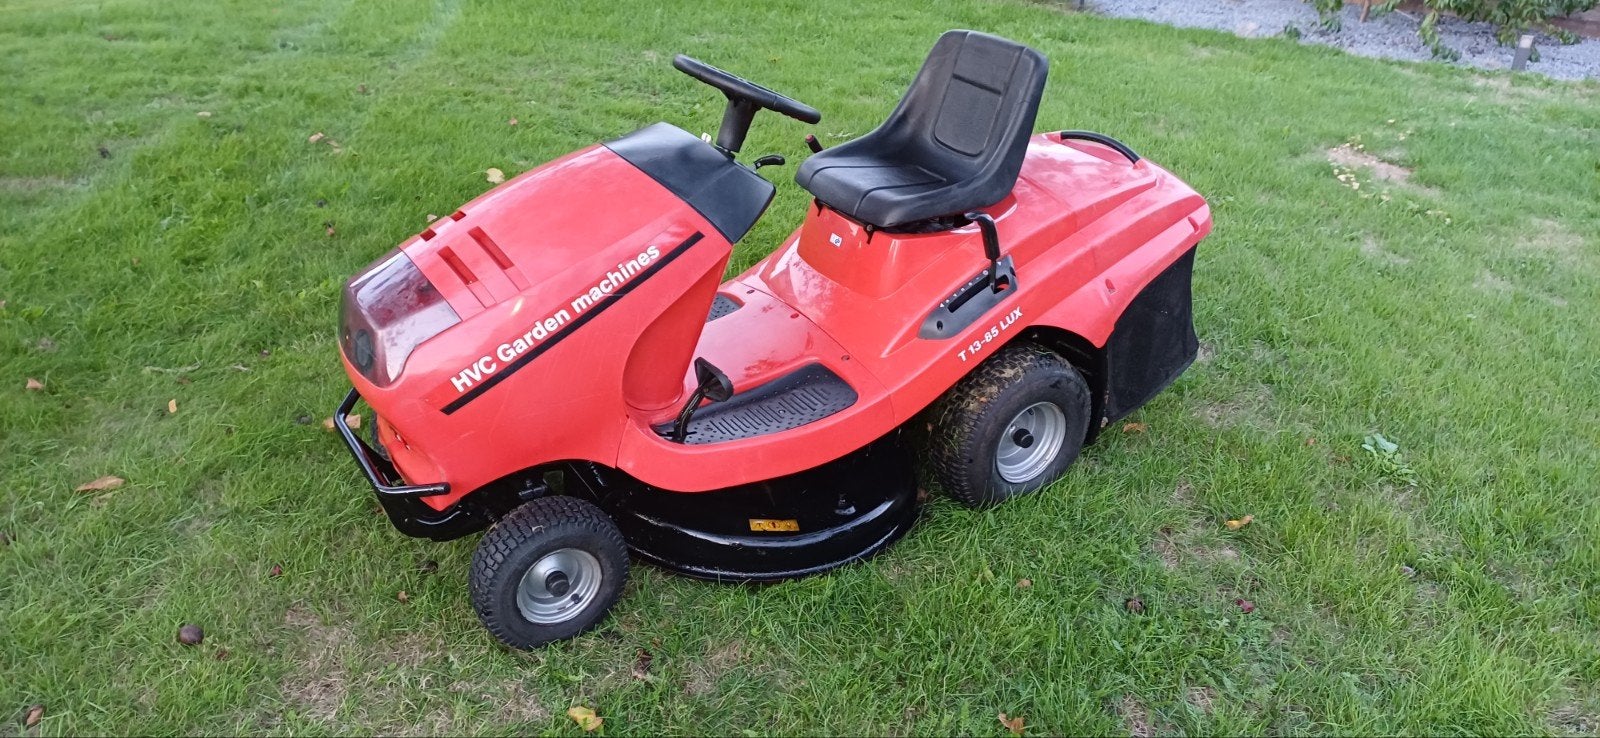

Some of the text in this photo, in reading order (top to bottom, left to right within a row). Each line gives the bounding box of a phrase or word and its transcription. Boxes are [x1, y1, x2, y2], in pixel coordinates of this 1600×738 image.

[450, 244, 661, 393] HVC Garden machines
[957, 306, 1023, 362] T 13-85 LUX
